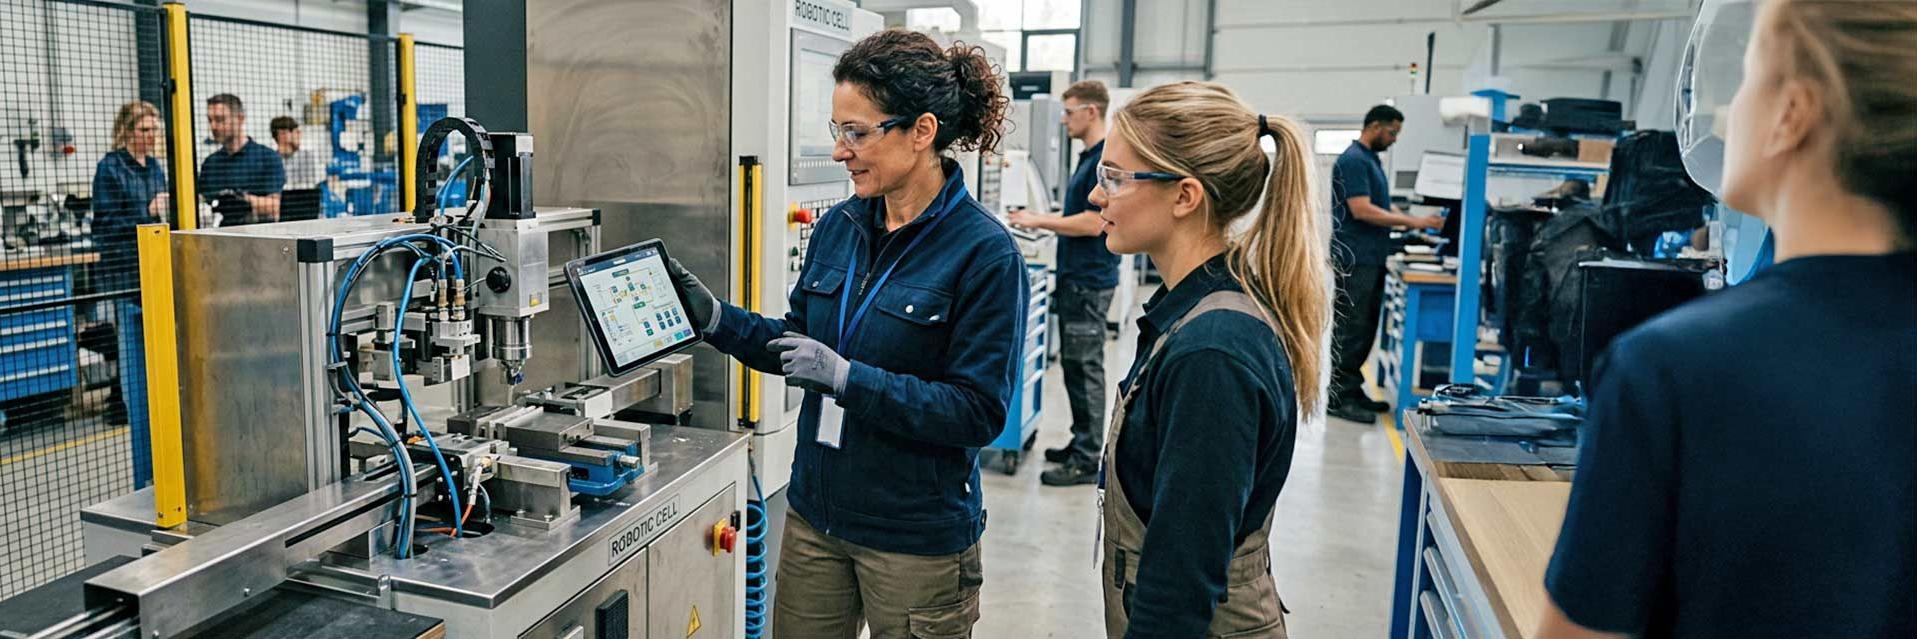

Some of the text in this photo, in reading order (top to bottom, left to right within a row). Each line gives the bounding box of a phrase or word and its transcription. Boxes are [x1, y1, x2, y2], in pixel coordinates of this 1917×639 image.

[795, 0, 849, 31] ROBOTIC CELL
[611, 502, 678, 557] ROBOTIC CELL
